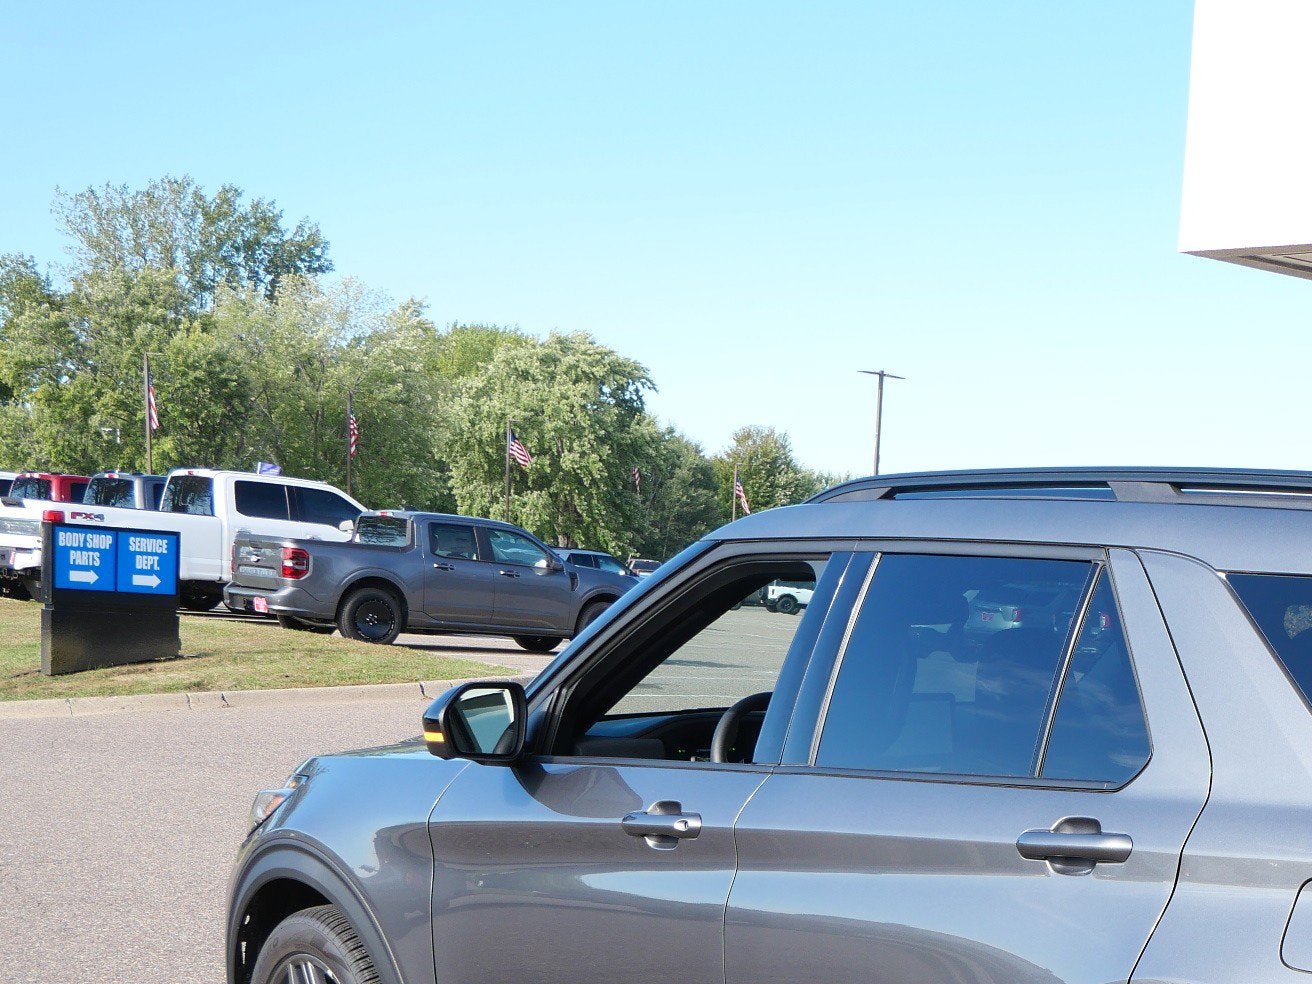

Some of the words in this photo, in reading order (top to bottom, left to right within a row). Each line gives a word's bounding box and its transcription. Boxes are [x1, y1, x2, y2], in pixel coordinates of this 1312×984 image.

[58, 531, 85, 548] BODY
[86, 533, 112, 550] SHOP
[129, 536, 168, 554] SERVICE
[69, 549, 101, 567] PARTS
[135, 554, 160, 571] DEPT.
